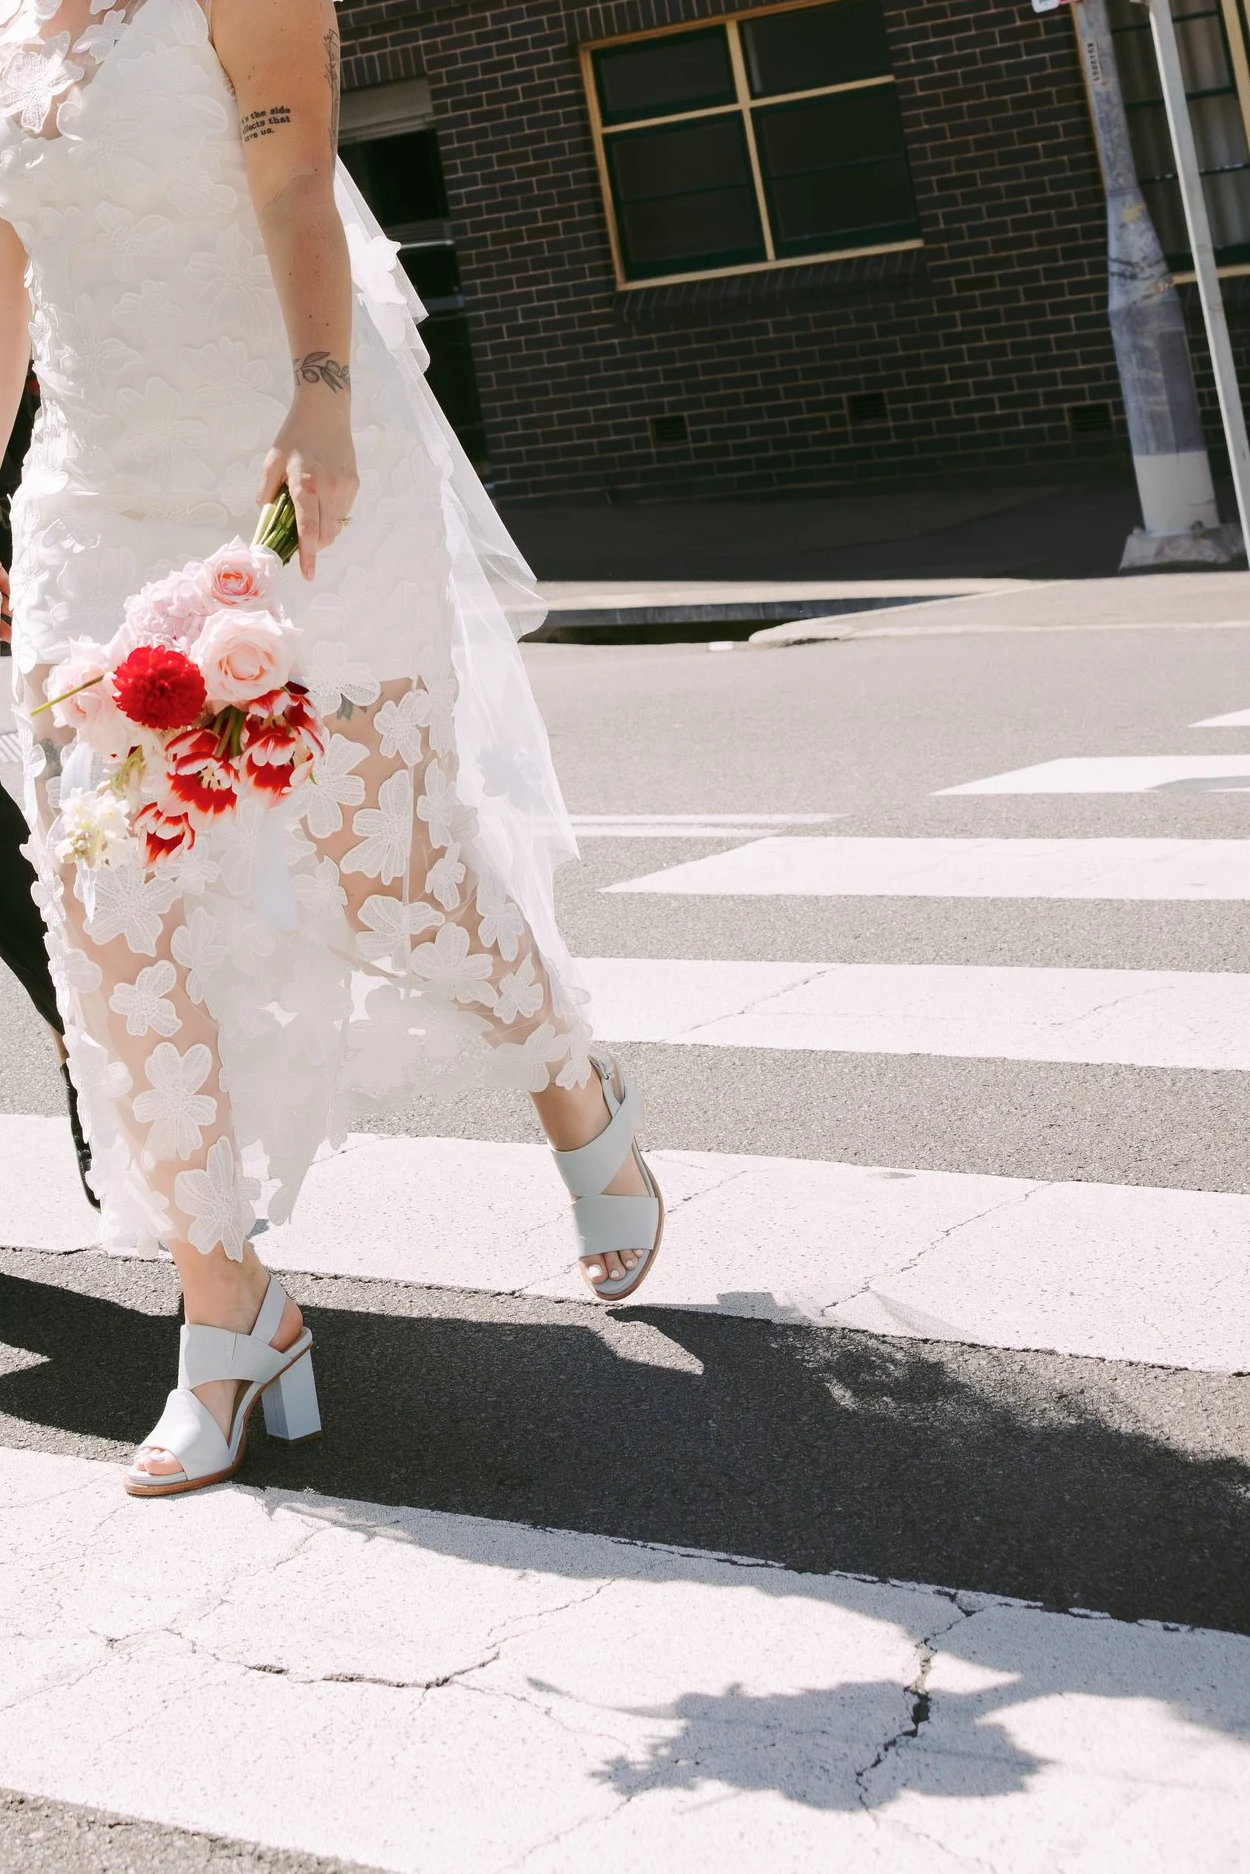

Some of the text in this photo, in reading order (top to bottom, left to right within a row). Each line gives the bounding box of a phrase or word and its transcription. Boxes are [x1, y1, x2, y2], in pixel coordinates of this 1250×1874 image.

[250, 111, 267, 119] the
[270, 106, 291, 115] side
[268, 115, 291, 125] that
